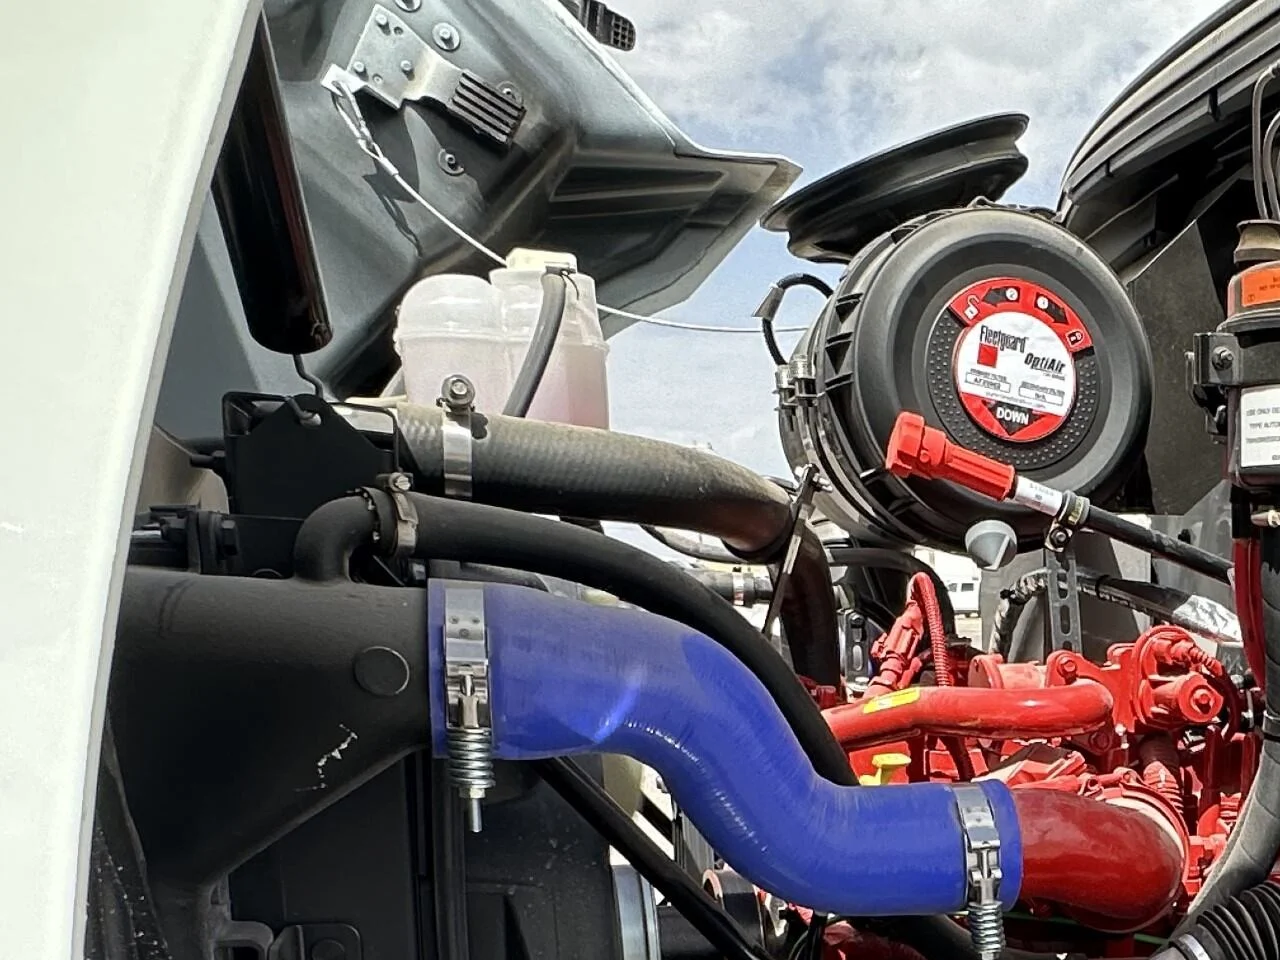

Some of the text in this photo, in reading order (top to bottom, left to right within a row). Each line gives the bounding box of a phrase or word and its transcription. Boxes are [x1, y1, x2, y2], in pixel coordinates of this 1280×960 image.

[980, 324, 1027, 353] Fleetguard
[1024, 352, 1066, 373] OptiAir
[996, 407, 1029, 425] DOWN
